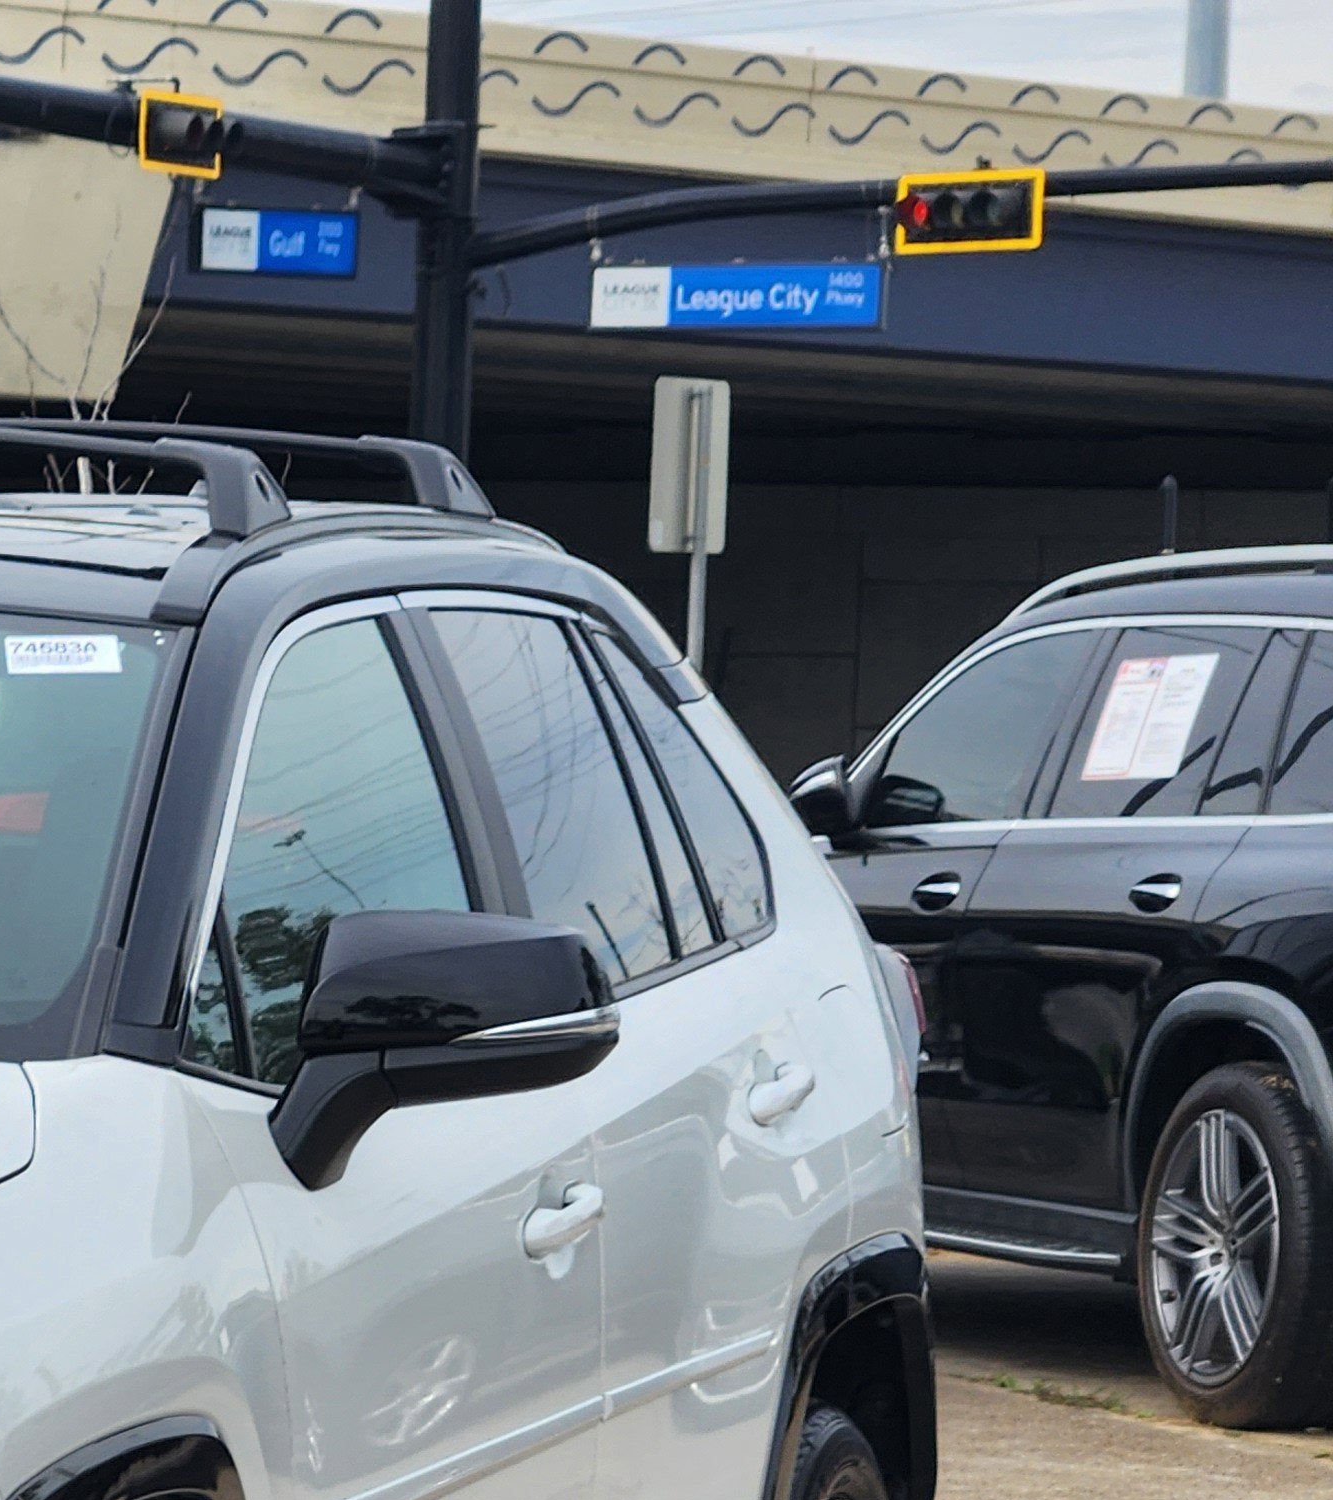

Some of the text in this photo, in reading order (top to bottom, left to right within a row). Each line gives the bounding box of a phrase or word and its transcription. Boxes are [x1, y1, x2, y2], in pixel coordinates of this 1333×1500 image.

[269, 229, 306, 257] Gulf
[602, 284, 661, 296] LEAGUE
[829, 271, 865, 288] 1400
[676, 282, 820, 318] League City
